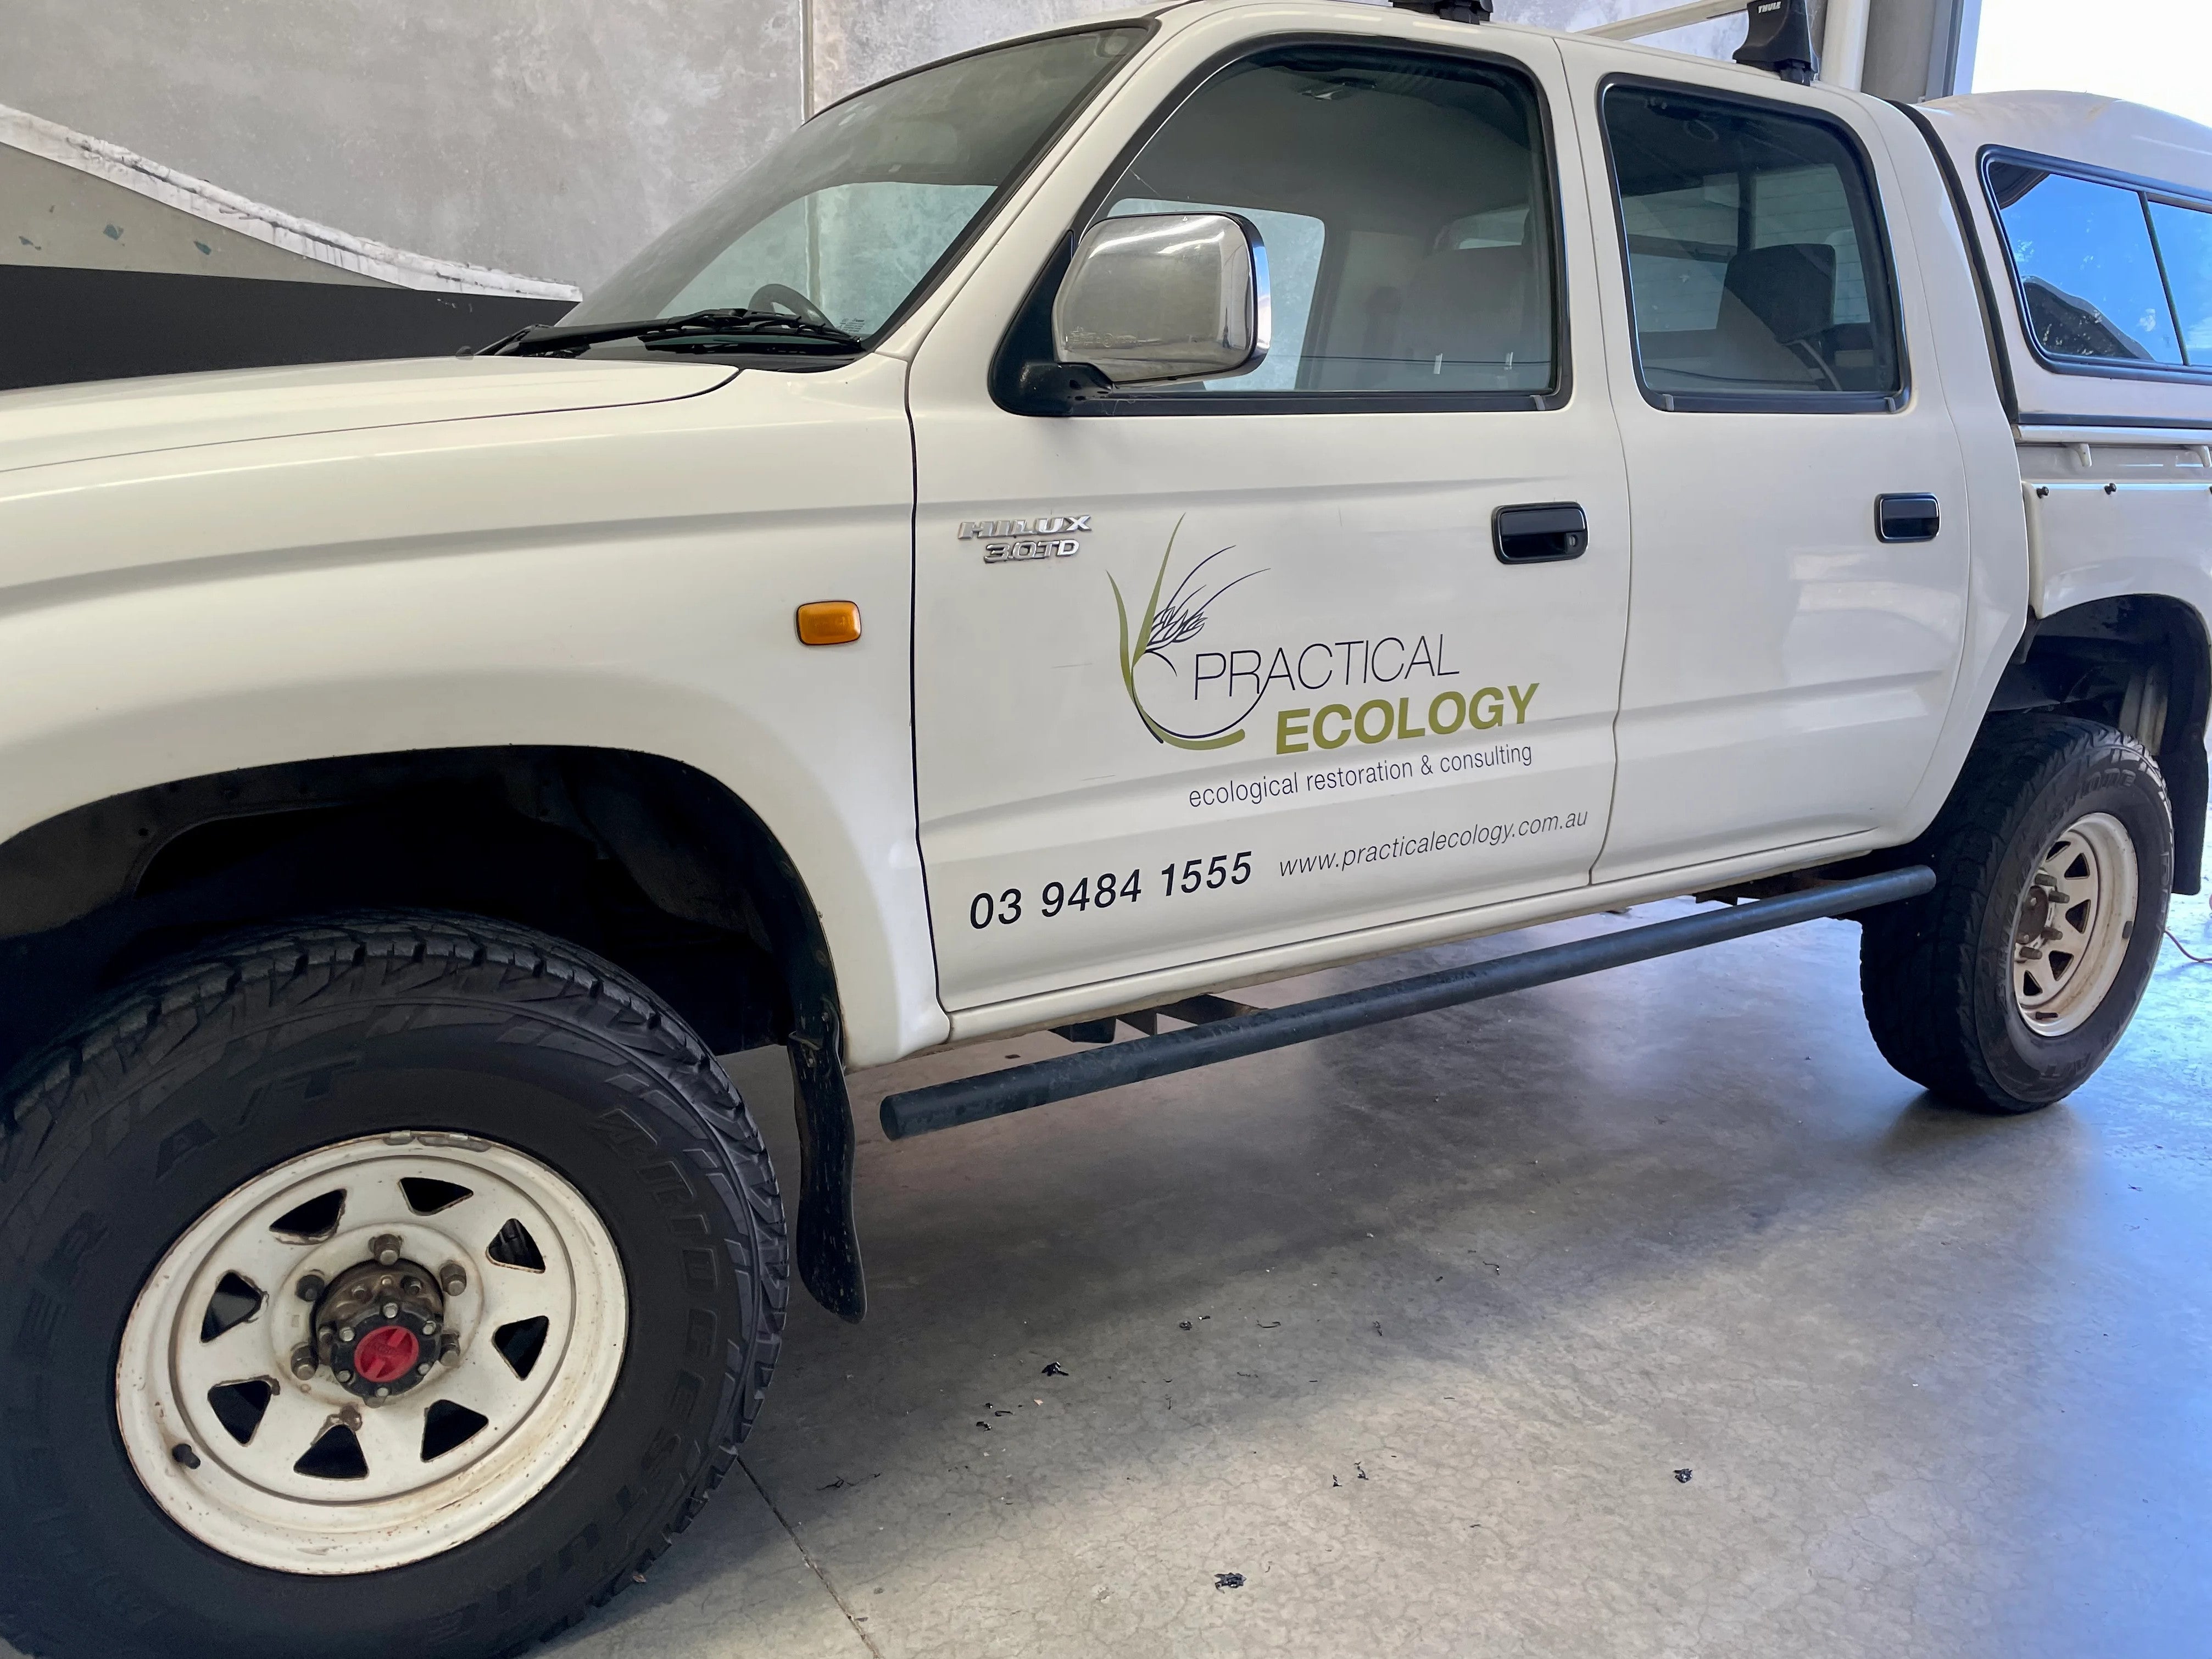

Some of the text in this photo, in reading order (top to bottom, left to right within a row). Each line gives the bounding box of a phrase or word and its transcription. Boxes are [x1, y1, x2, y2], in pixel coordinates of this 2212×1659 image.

[1758, 1, 1781, 14] THULE
[958, 515, 1092, 539] HILUX
[1194, 633, 1461, 701] PRACTICAL
[1275, 682, 1541, 756] ECOLOGY
[1189, 745, 1533, 808] ecological restoration & consulting
[1279, 810, 1589, 877] www.practicalecology.com.au
[970, 850, 1252, 930] 03 9484 1555
